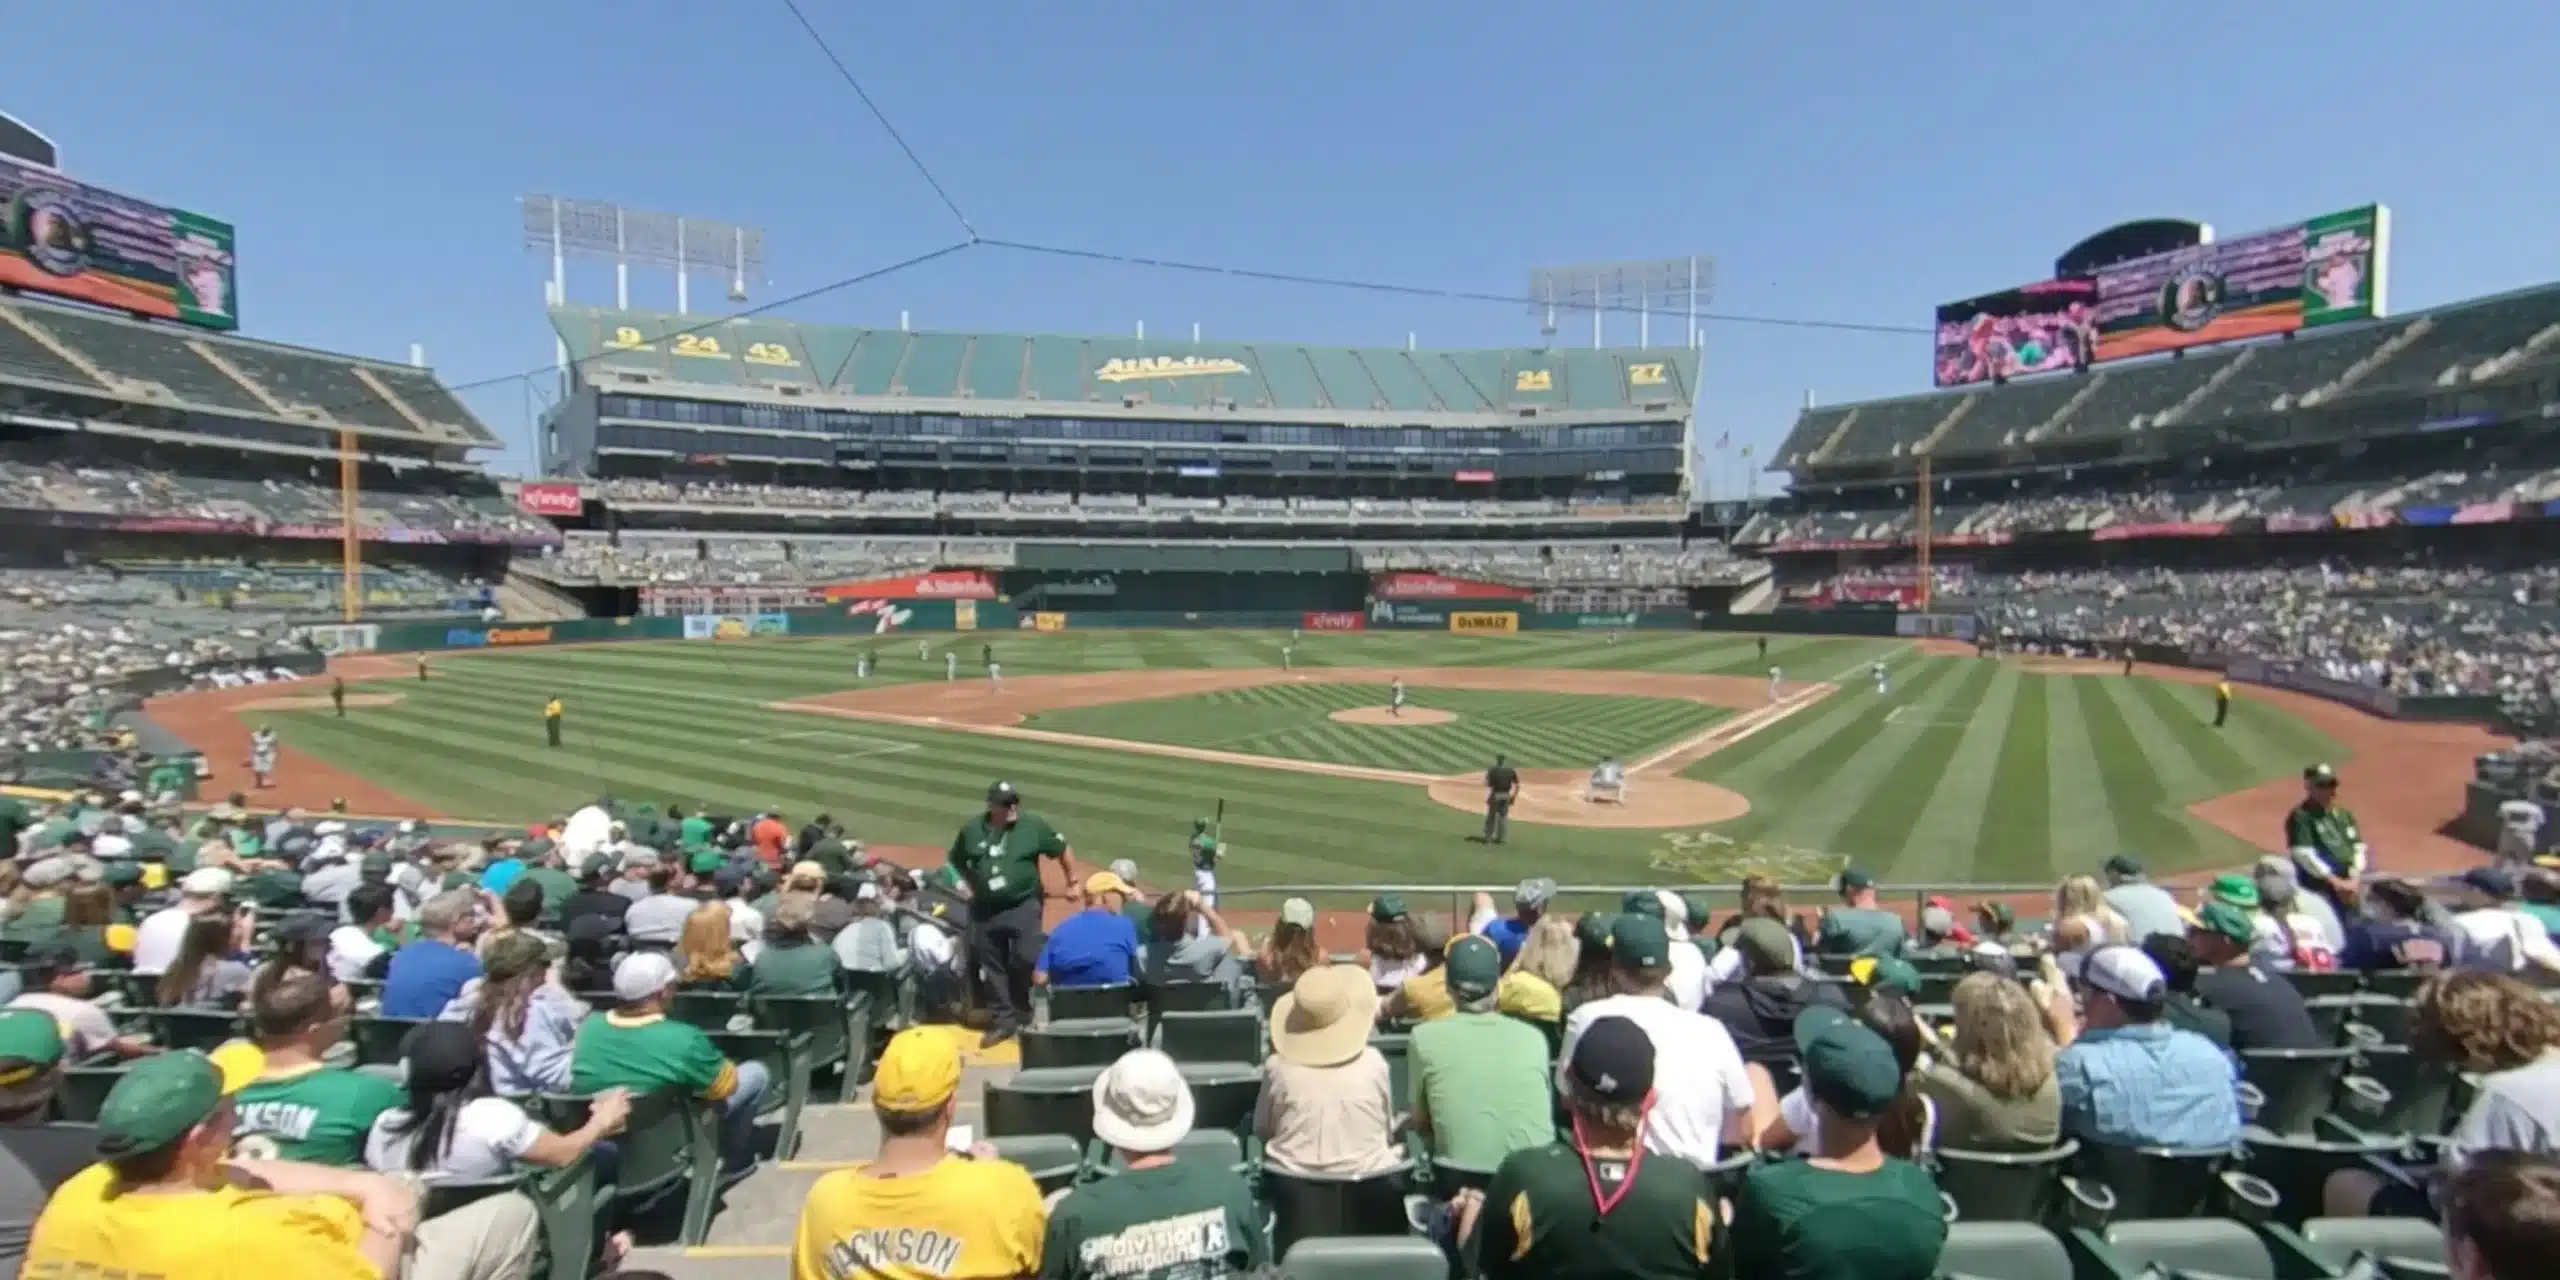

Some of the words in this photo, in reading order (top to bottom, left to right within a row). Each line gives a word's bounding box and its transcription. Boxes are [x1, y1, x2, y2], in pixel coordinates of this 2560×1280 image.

[616, 327, 642, 345] 9
[676, 334, 720, 352] 24
[749, 343, 791, 363] 43
[1629, 364, 1664, 382] 27
